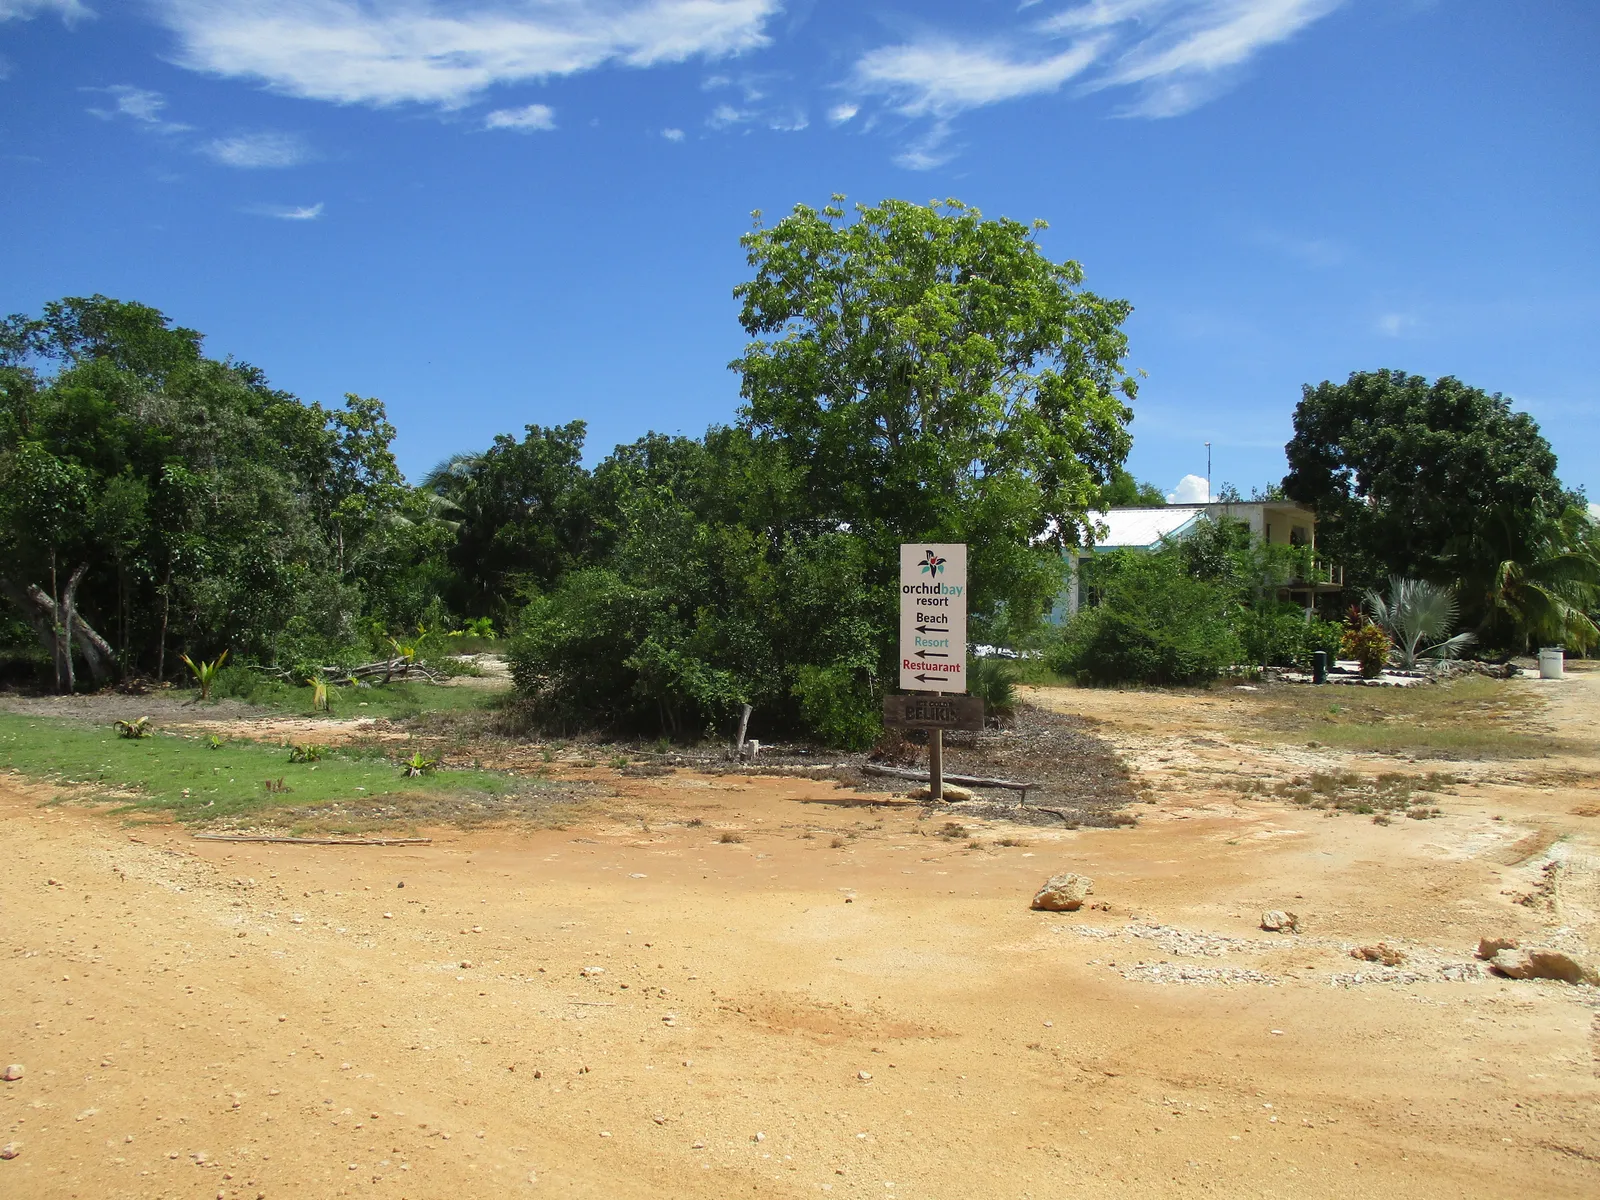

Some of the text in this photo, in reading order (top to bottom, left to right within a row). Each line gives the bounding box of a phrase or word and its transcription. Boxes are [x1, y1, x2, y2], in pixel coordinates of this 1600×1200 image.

[902, 582, 963, 597] orchidbay
[916, 597, 949, 607] resort
[916, 612, 948, 624] Beach
[914, 636, 949, 648] Resort
[903, 659, 961, 673] Restuarant
